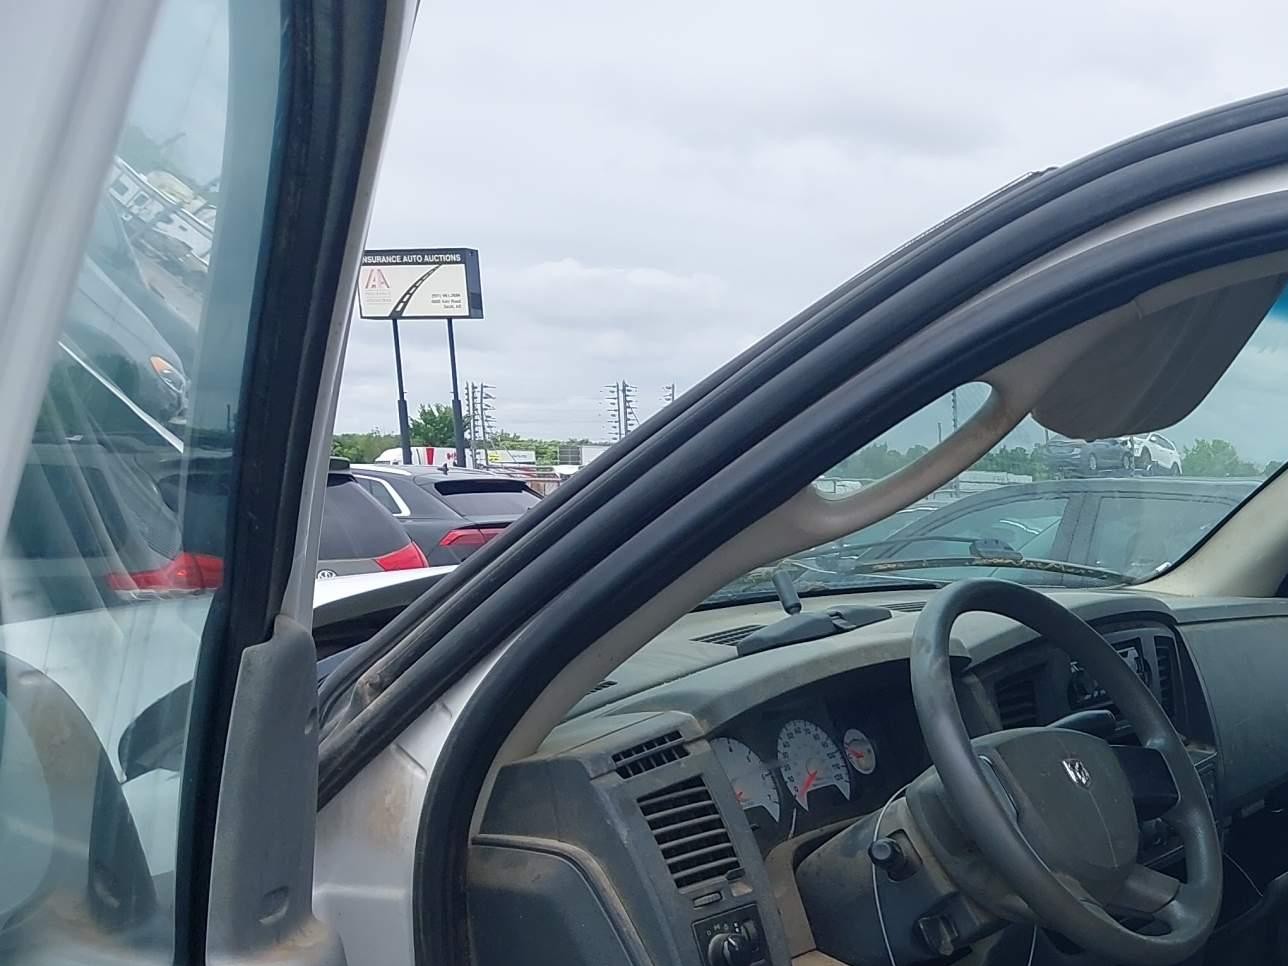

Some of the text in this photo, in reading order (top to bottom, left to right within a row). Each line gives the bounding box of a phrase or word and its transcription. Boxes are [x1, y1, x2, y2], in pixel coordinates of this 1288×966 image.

[362, 254, 461, 263] NSURANCE AUTO AUCTIONS
